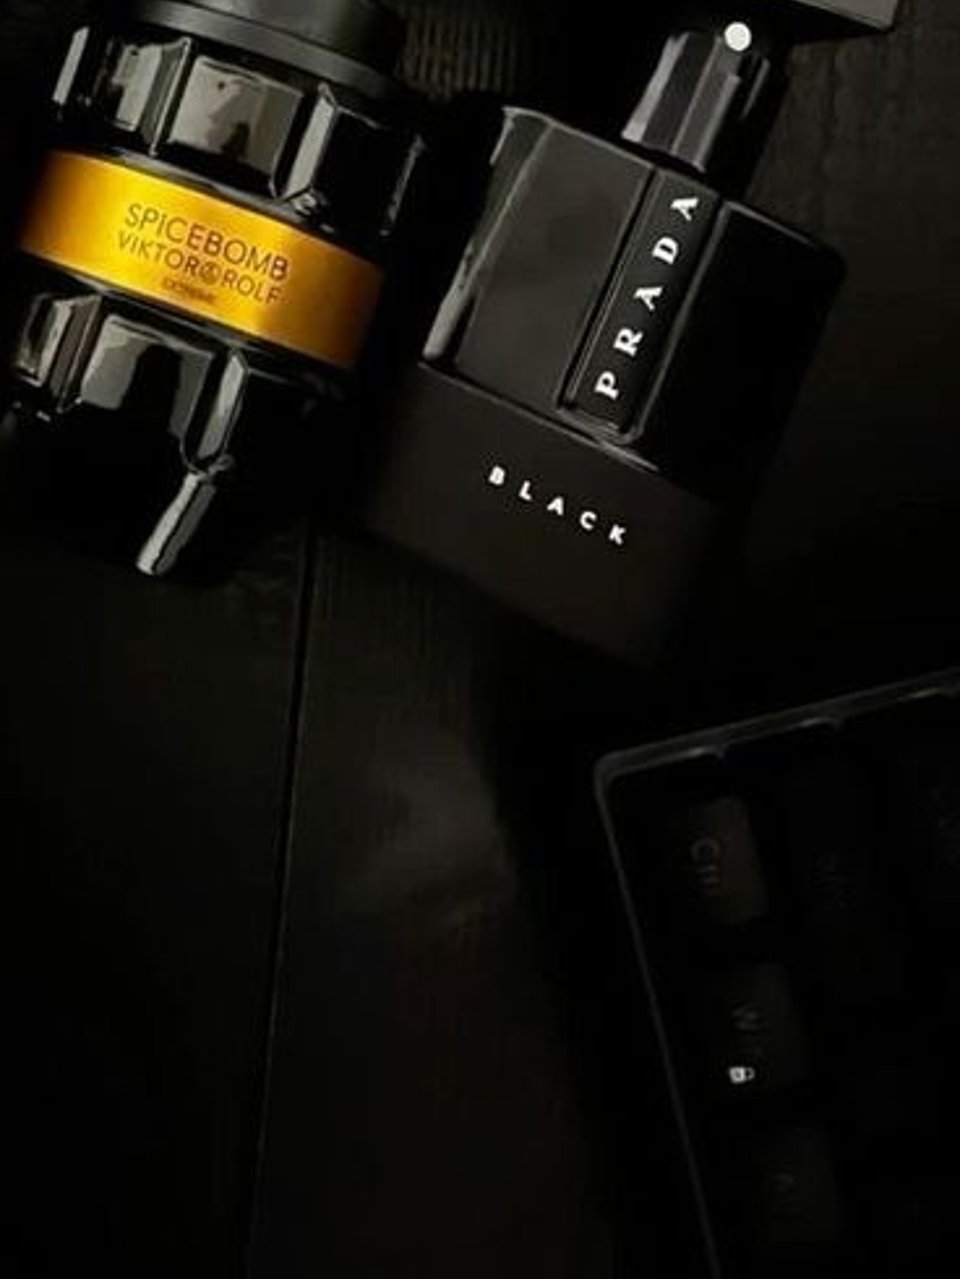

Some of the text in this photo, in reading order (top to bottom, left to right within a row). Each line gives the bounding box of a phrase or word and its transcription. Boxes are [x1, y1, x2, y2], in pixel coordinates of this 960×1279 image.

[124, 203, 289, 282] SPICEBOMB
[594, 196, 700, 400] PRADA
[489, 466, 626, 545] BLACK
